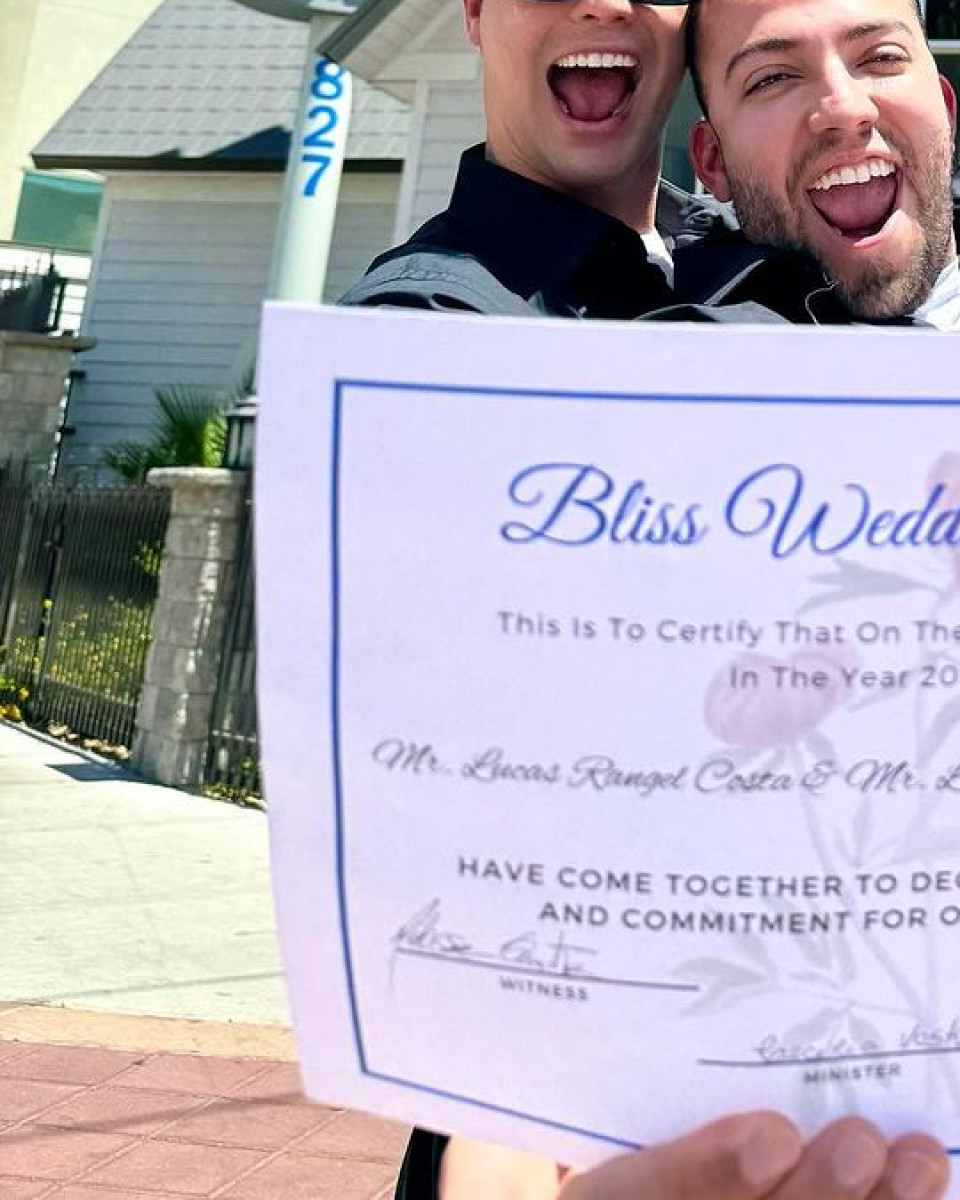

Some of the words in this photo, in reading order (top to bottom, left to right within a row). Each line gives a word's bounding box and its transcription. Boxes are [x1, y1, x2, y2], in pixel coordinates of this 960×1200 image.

[300, 55, 343, 197] 827
[501, 462, 707, 547] Bliss
[498, 611, 561, 638] This
[572, 617, 596, 640] Is
[608, 617, 646, 642] To
[656, 618, 763, 649] Certify
[775, 620, 844, 645] That
[856, 621, 900, 644] On
[730, 665, 758, 688] In
[773, 665, 829, 689] The
[841, 666, 909, 689] Year
[371, 737, 453, 776] Mr.
[461, 745, 562, 784] Lucas
[566, 755, 688, 798] Rangel
[694, 758, 793, 794] Costa
[801, 758, 840, 794] &
[845, 758, 928, 792] Mr.
[458, 856, 545, 887] HAVE
[557, 866, 652, 894] COME
[665, 873, 843, 897] TOGETHER
[855, 872, 898, 895] TO
[538, 901, 610, 927] AND
[621, 908, 851, 934] COMMITMENT
[863, 908, 928, 931] FOR
[499, 974, 591, 1002] WITNESS
[804, 1060, 901, 1085] MINISTER
